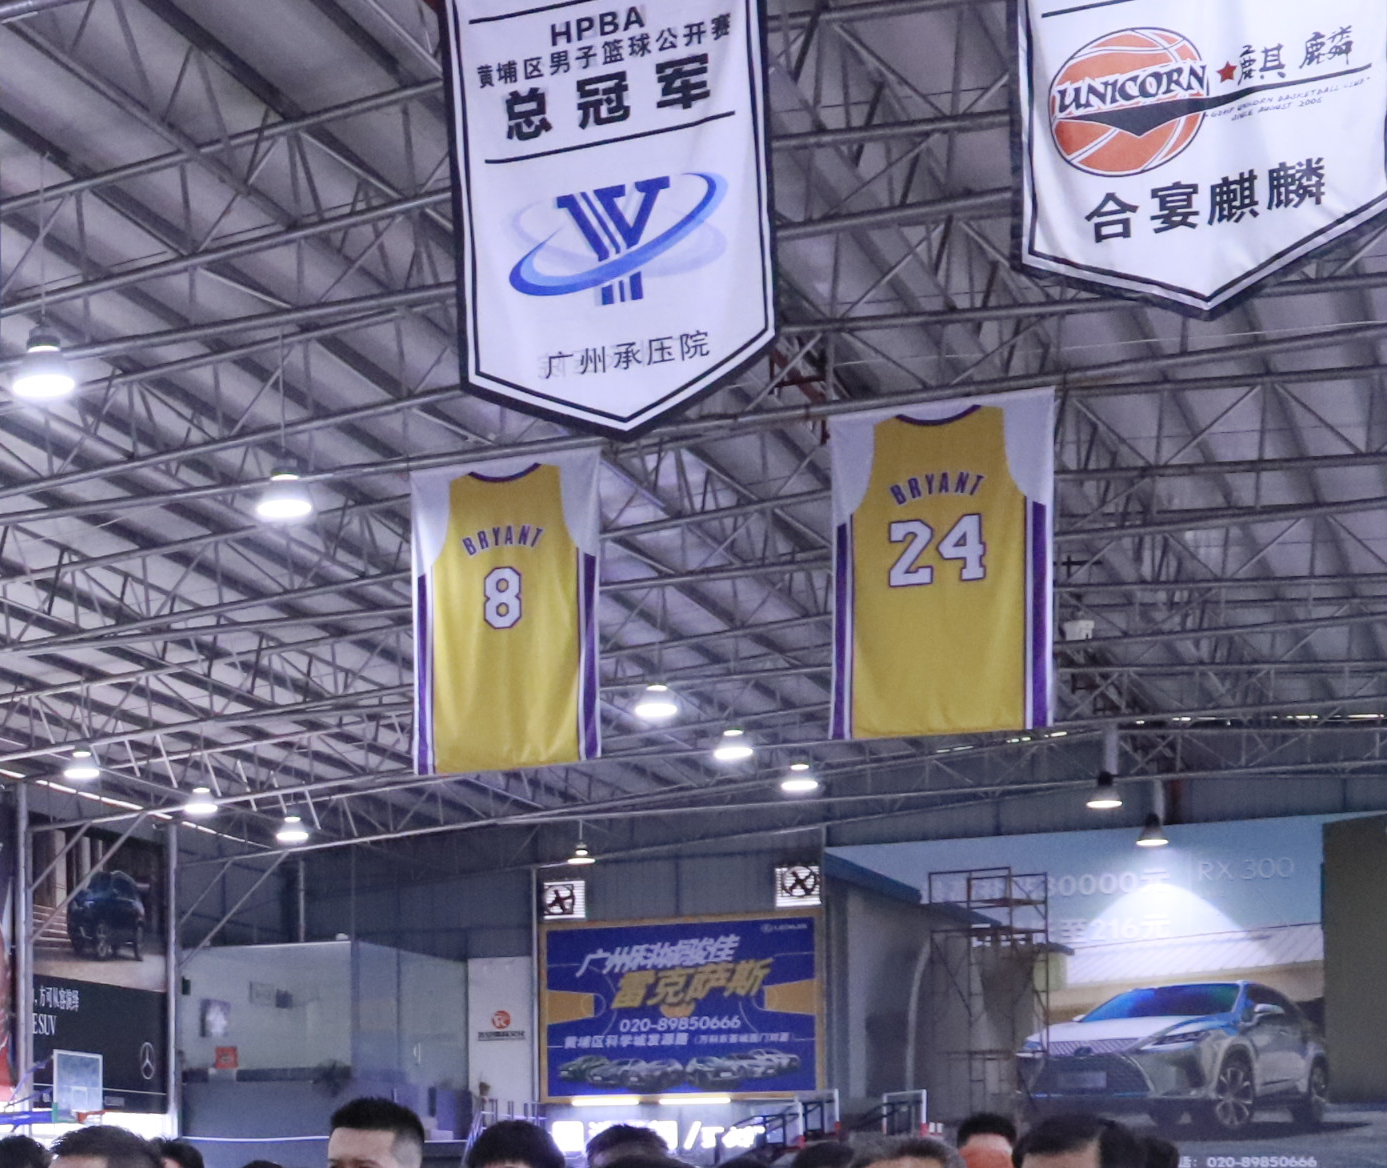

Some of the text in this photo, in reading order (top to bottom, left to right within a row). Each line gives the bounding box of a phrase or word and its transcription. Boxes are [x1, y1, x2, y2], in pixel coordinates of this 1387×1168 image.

[477, 12, 732, 89] 黄埔区男子篮球公开赛
[550, 6, 645, 46] HPBA
[505, 52, 712, 142] 总冠军
[1056, 64, 1209, 113] UNICORN
[1084, 158, 1326, 243] 合宴麒麟
[545, 329, 711, 380] 广州承压院
[889, 471, 985, 506] BRYANT
[462, 525, 544, 556] BRYANT
[888, 513, 987, 588] 24
[483, 566, 522, 630] 8
[1242, 856, 1295, 880] 300
[611, 957, 776, 1010] 雷克萨斯
[619, 1015, 741, 1033] 020-89850666
